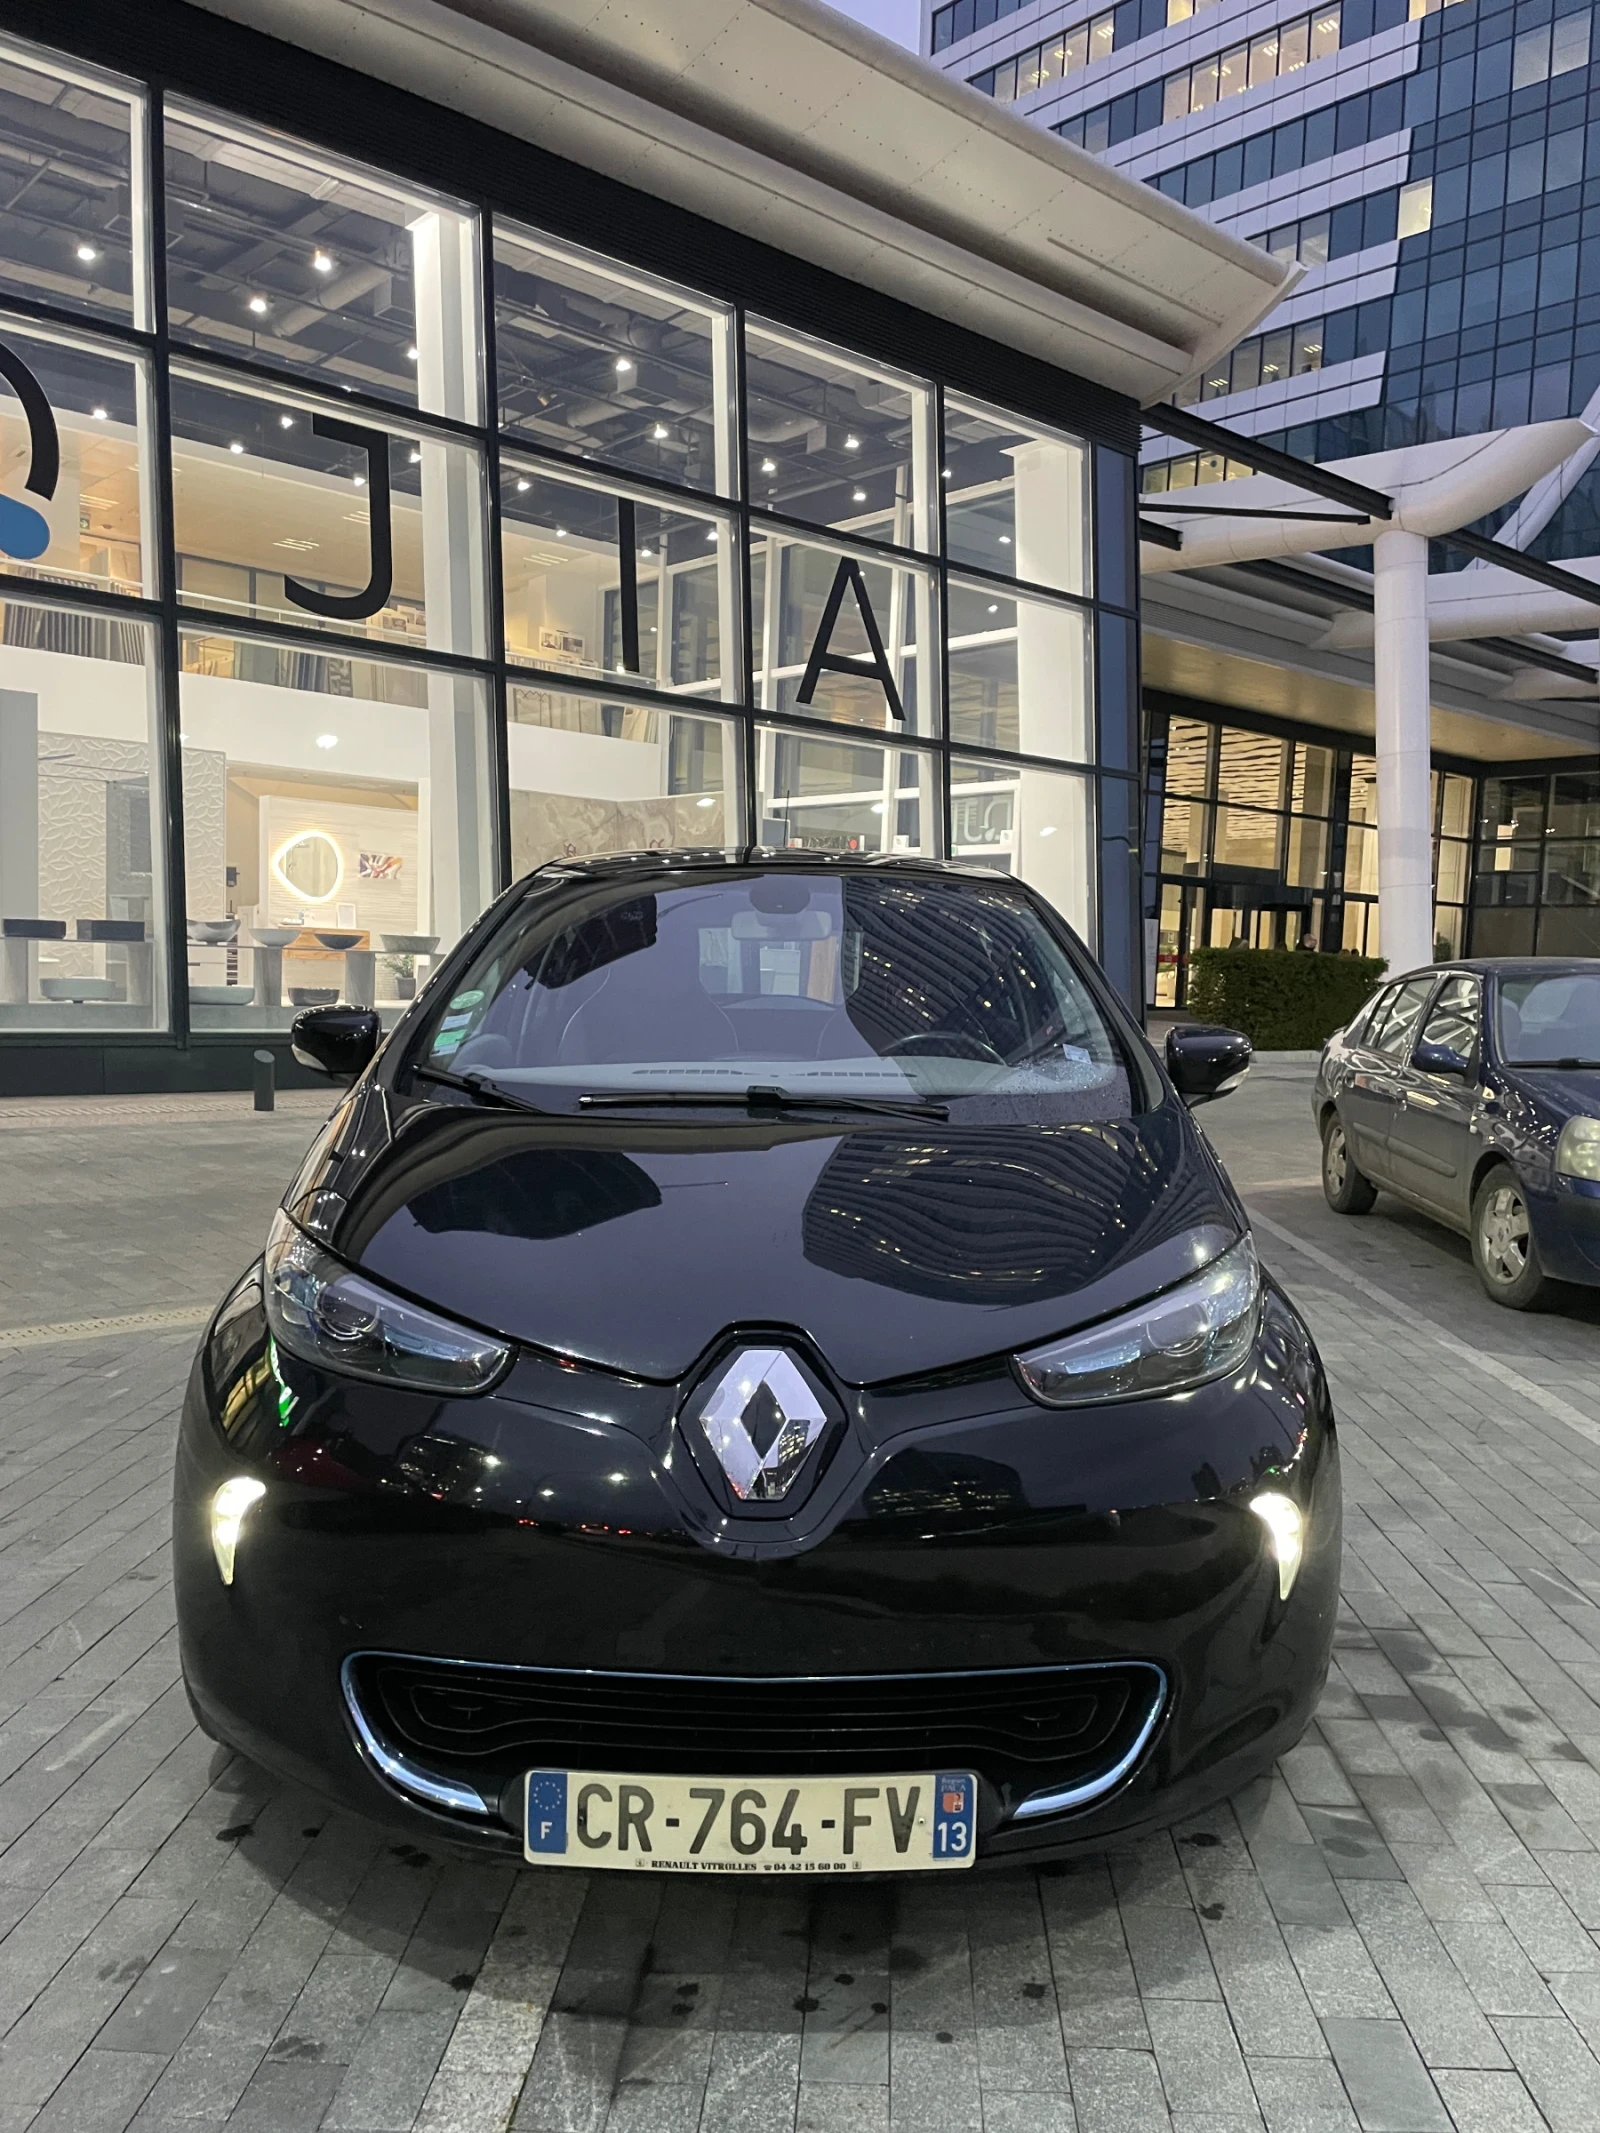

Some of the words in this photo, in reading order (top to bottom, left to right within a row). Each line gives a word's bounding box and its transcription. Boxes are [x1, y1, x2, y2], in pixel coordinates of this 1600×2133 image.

[0, 343, 906, 721] JIA
[540, 1821, 552, 1839] F
[577, 1783, 921, 1855] CR-764-FV
[937, 1821, 967, 1852] 13
[651, 1860, 698, 1870] RENAULT
[701, 1862, 757, 1871] VITROLLES
[773, 1863, 786, 1871] 04
[789, 1863, 801, 1871] 42
[804, 1863, 815, 1871] 15
[833, 1862, 846, 1870] 00
